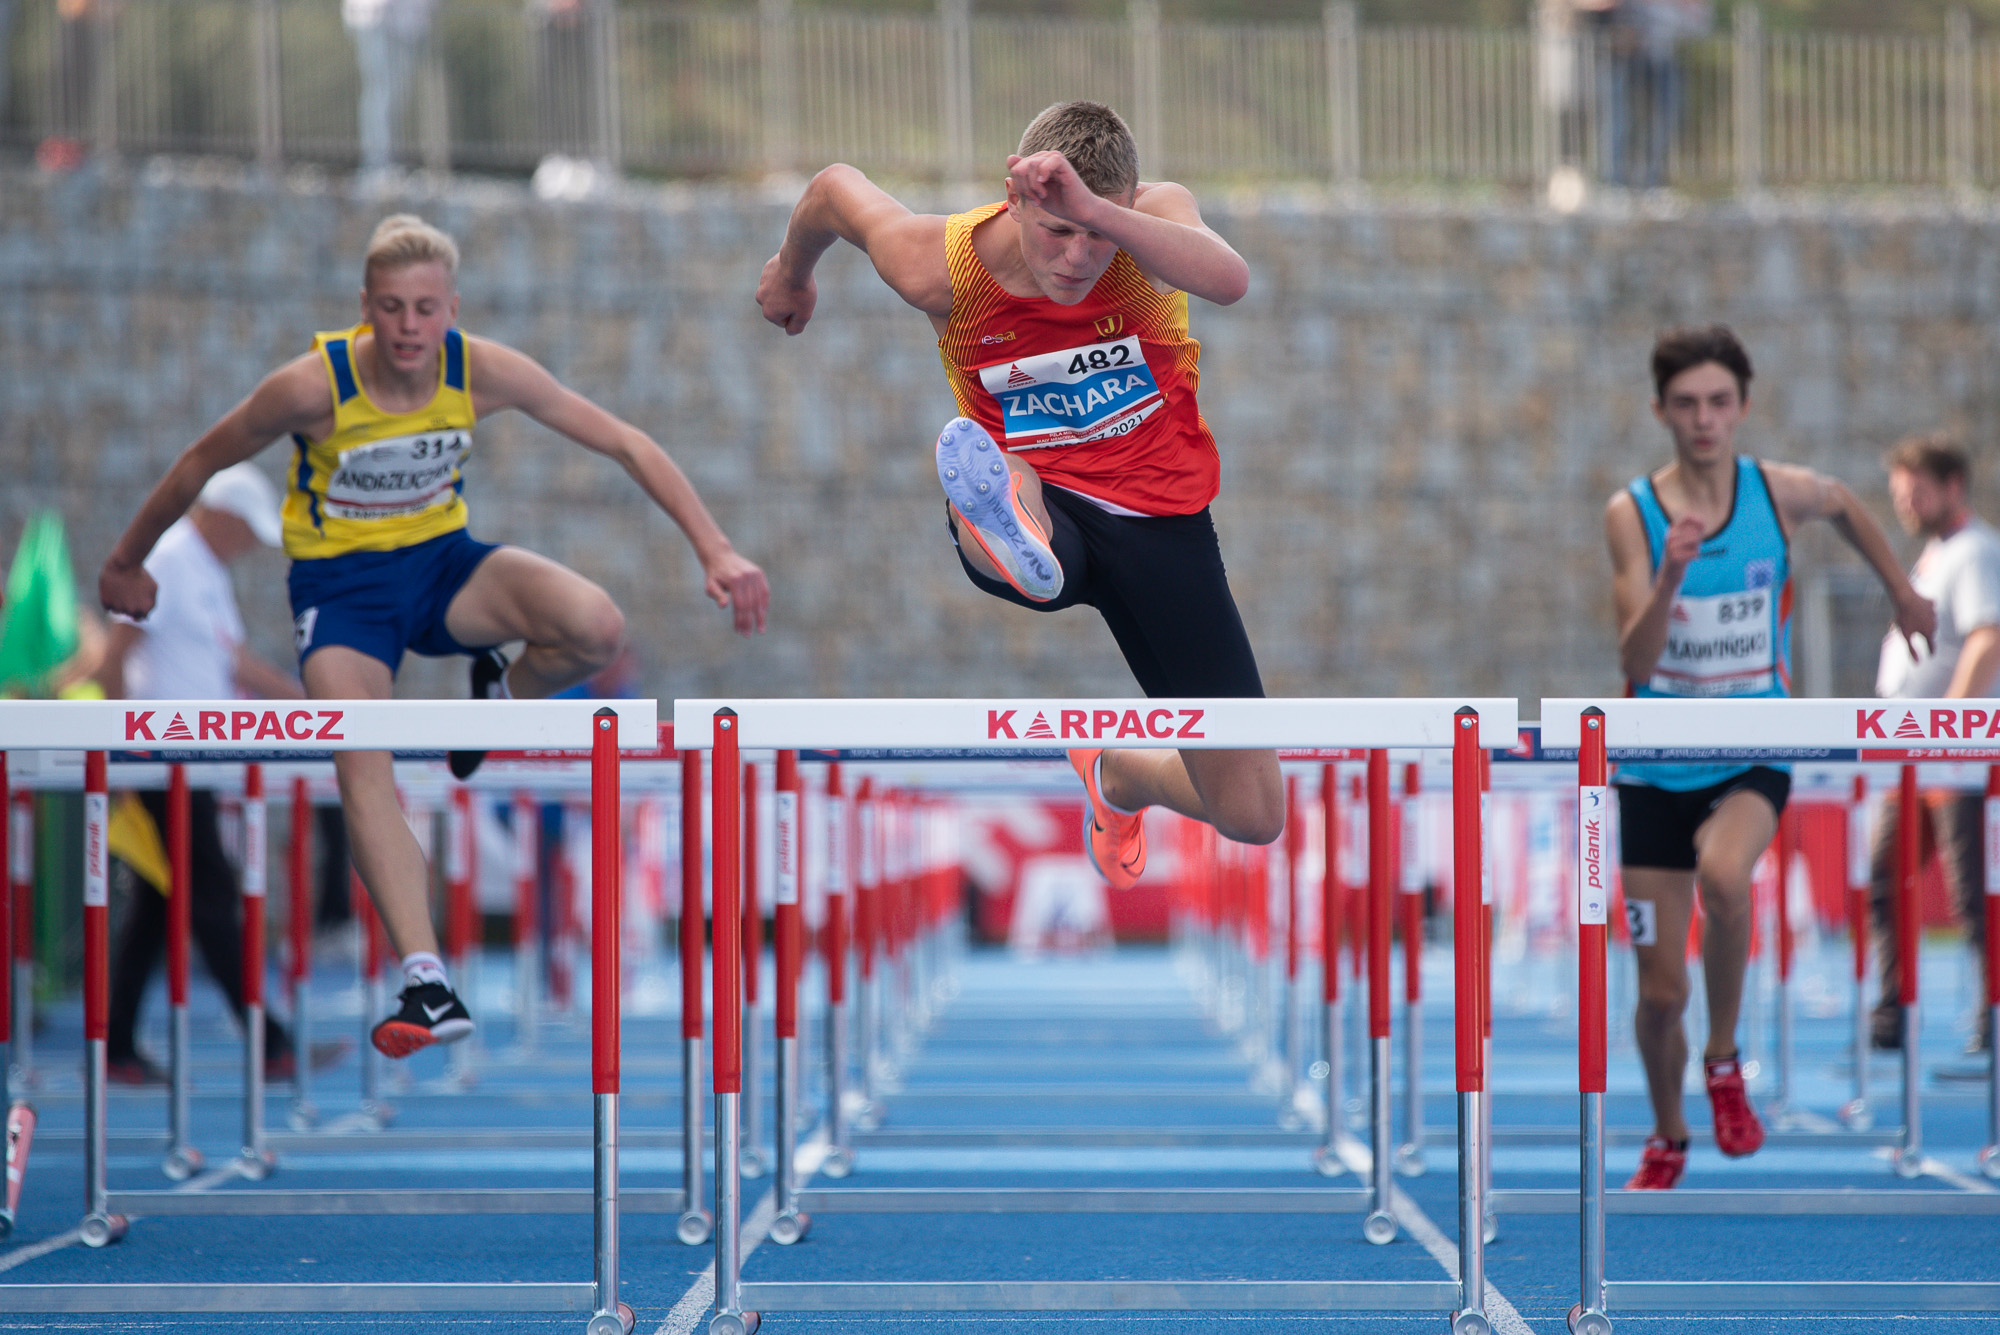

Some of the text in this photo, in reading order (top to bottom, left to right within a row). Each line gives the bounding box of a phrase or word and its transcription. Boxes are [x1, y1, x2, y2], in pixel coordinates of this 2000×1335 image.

[1067, 344, 1134, 375] 482
[1003, 374, 1148, 417] ZACHARA
[1007, 379, 1037, 389] KARPACZ
[1110, 413, 1143, 437] 2021
[1719, 597, 1764, 624] 839
[126, 711, 343, 740] KARPACZ
[988, 709, 1204, 739] KARPACZ
[1585, 818, 1603, 890] polanik
